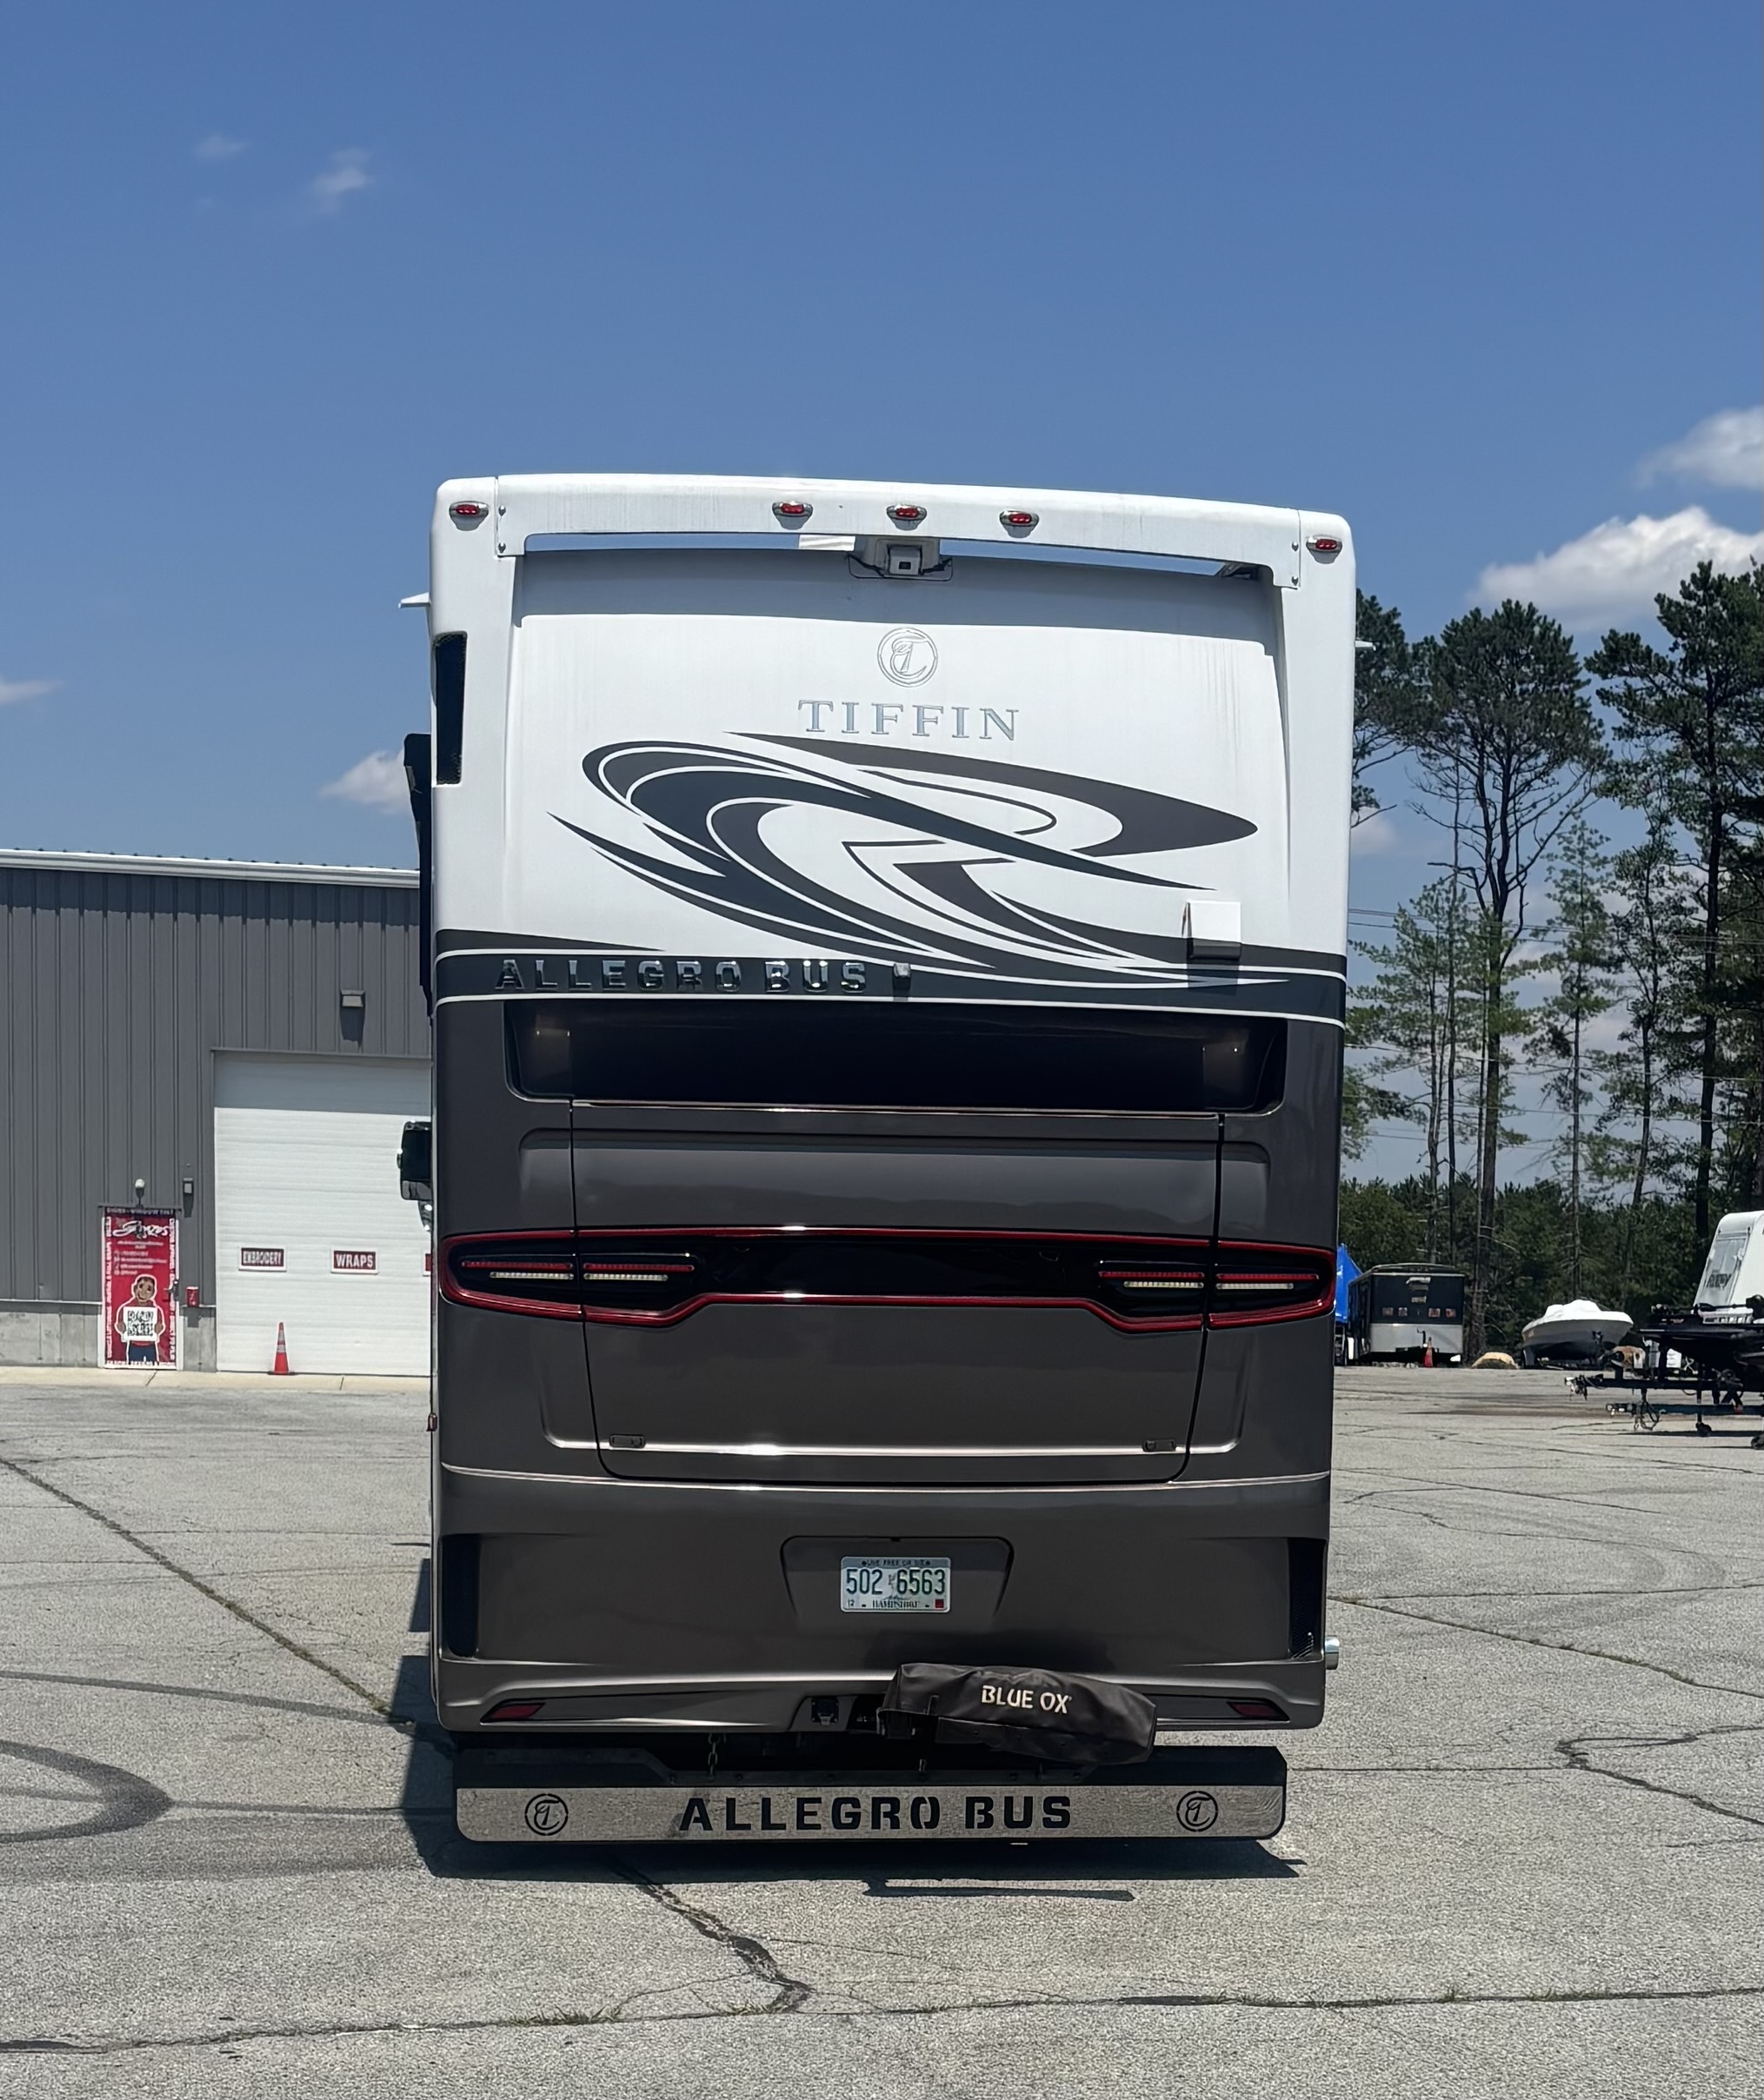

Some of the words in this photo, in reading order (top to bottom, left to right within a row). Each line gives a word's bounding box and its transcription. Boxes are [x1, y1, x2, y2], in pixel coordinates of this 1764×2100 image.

[797, 699, 1019, 741] TIFFIN
[495, 959, 742, 993] ALLEGRO
[764, 960, 865, 994] BUS
[336, 1253, 374, 1268] WRAPS
[846, 1568, 883, 1595] 502
[896, 1569, 946, 1595] 6563
[982, 1685, 1034, 1710] BLUE
[1040, 1691, 1069, 1714] OX
[678, 1796, 941, 1831] ALLEGRO
[965, 1796, 1071, 1829] BUS
